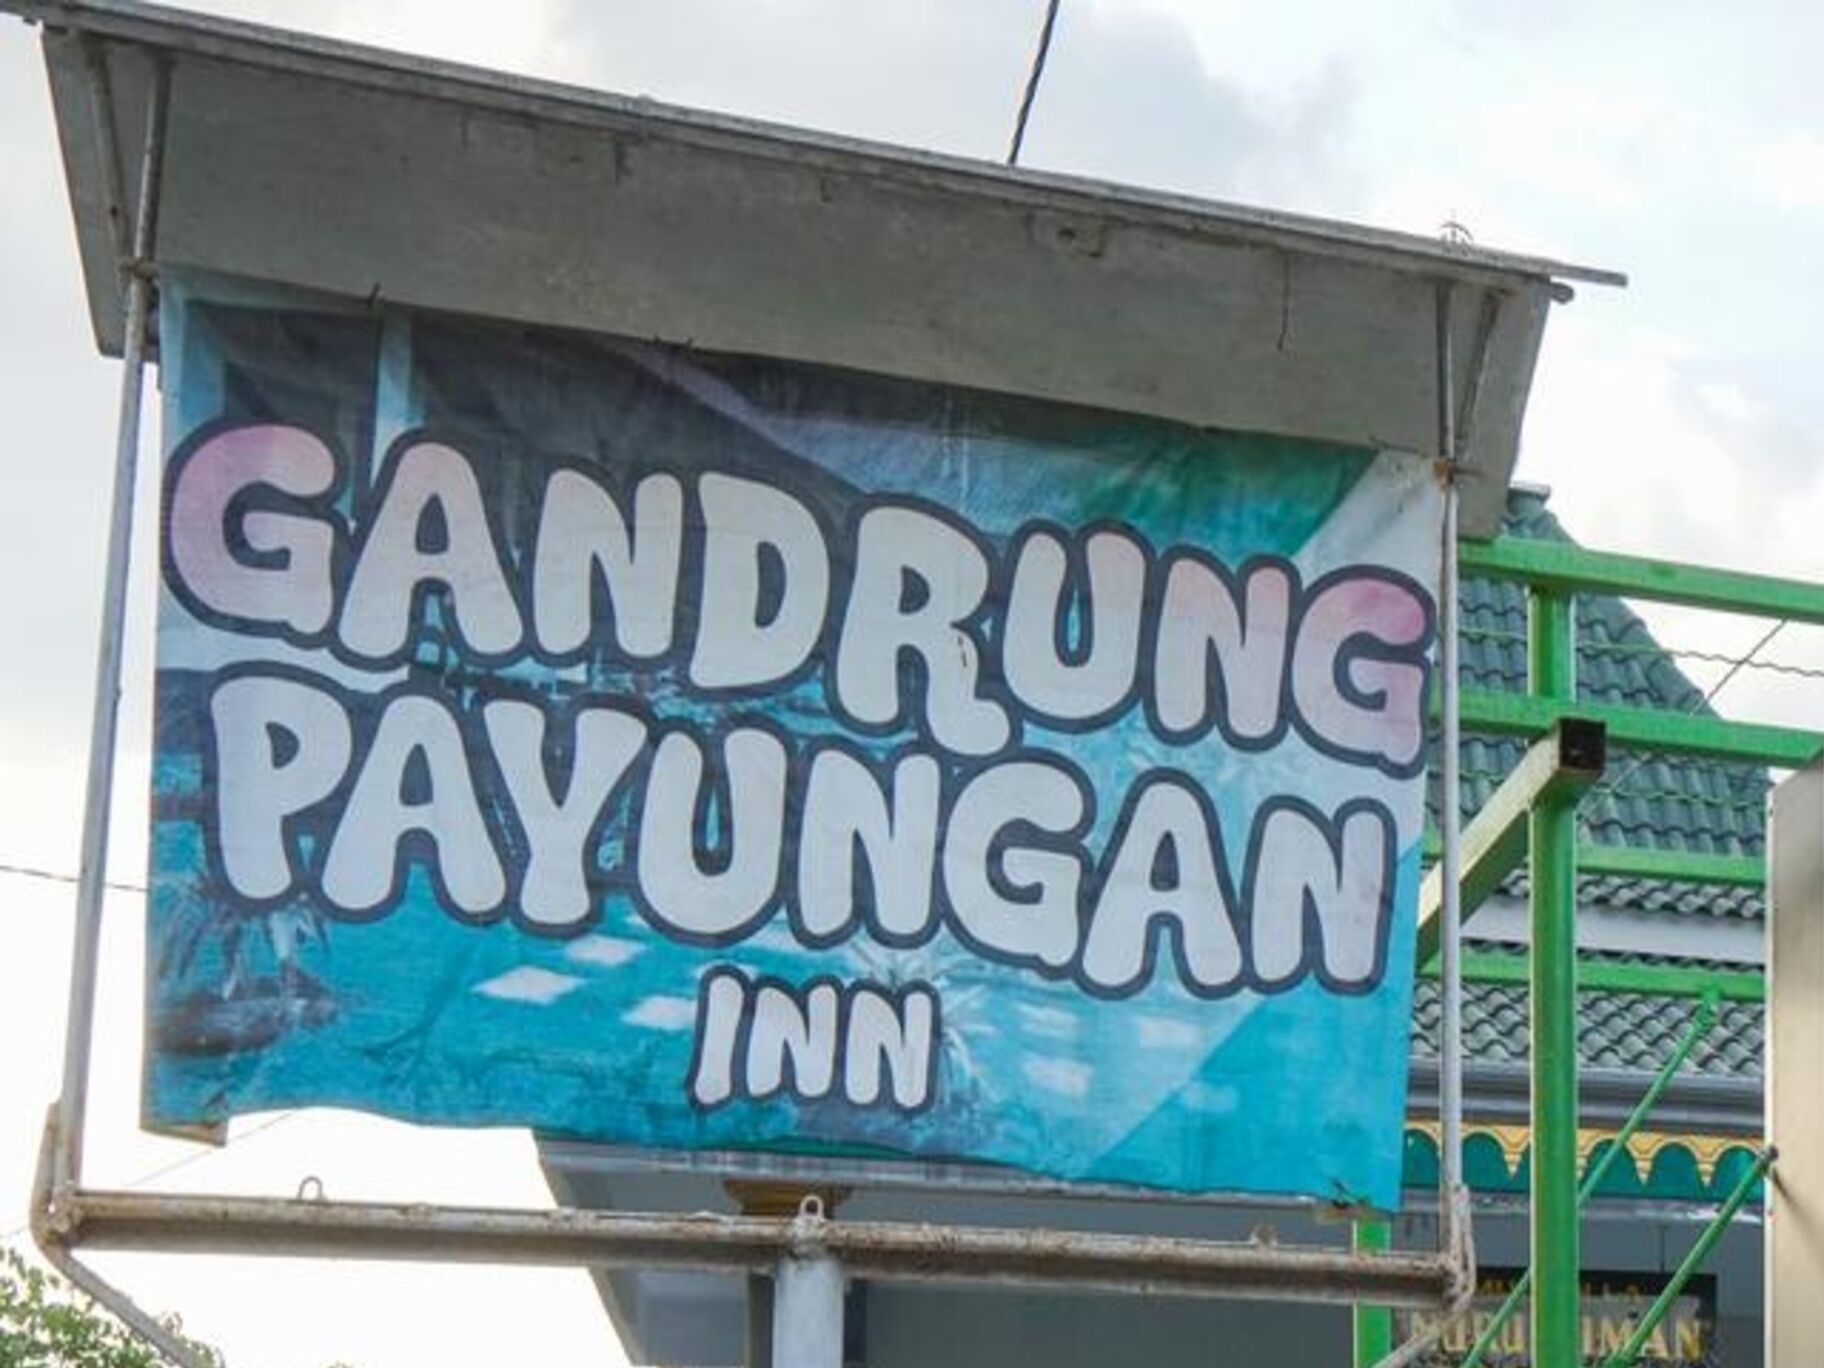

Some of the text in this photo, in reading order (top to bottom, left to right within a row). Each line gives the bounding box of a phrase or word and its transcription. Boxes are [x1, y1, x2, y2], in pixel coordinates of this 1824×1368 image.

[165, 421, 1432, 775] GANDRUNG
[207, 673, 1390, 992] PAYUNGAN
[689, 968, 936, 1110] INN
